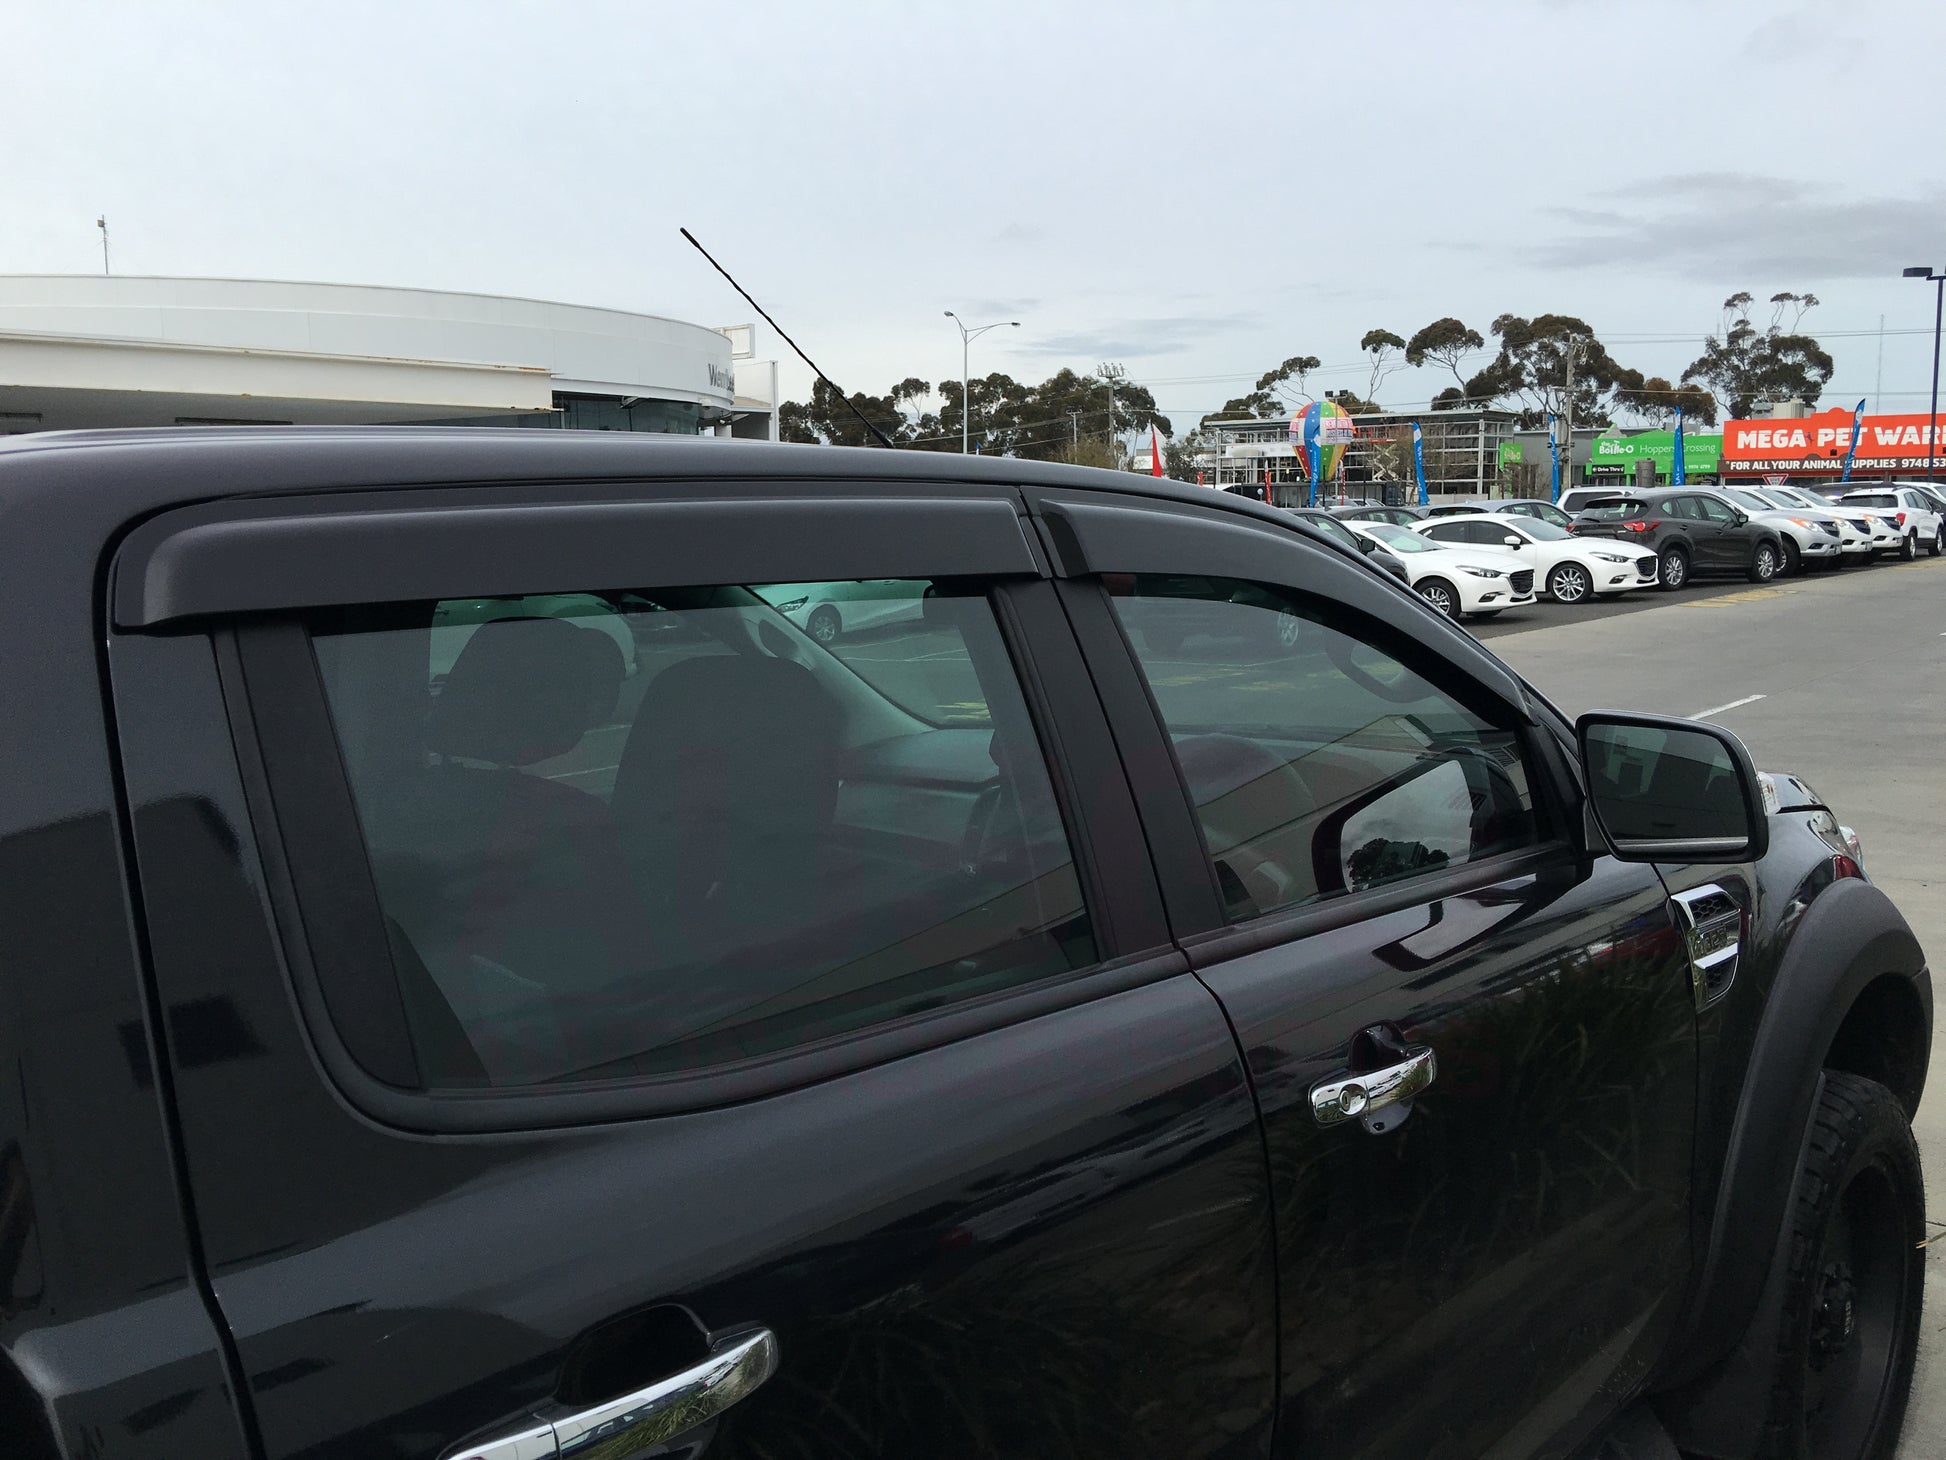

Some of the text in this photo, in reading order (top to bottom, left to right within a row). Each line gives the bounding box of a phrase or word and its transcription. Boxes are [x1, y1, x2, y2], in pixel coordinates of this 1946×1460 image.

[1737, 428, 1806, 449] MEGA
[1817, 427, 1868, 447] PET
[1752, 461, 1770, 470] ALL
[1771, 460, 1800, 469] YOUR
[1802, 460, 1843, 469] ANIMAL
[1845, 459, 1896, 469] UPPLIES
[1901, 458, 1930, 468] 9748
